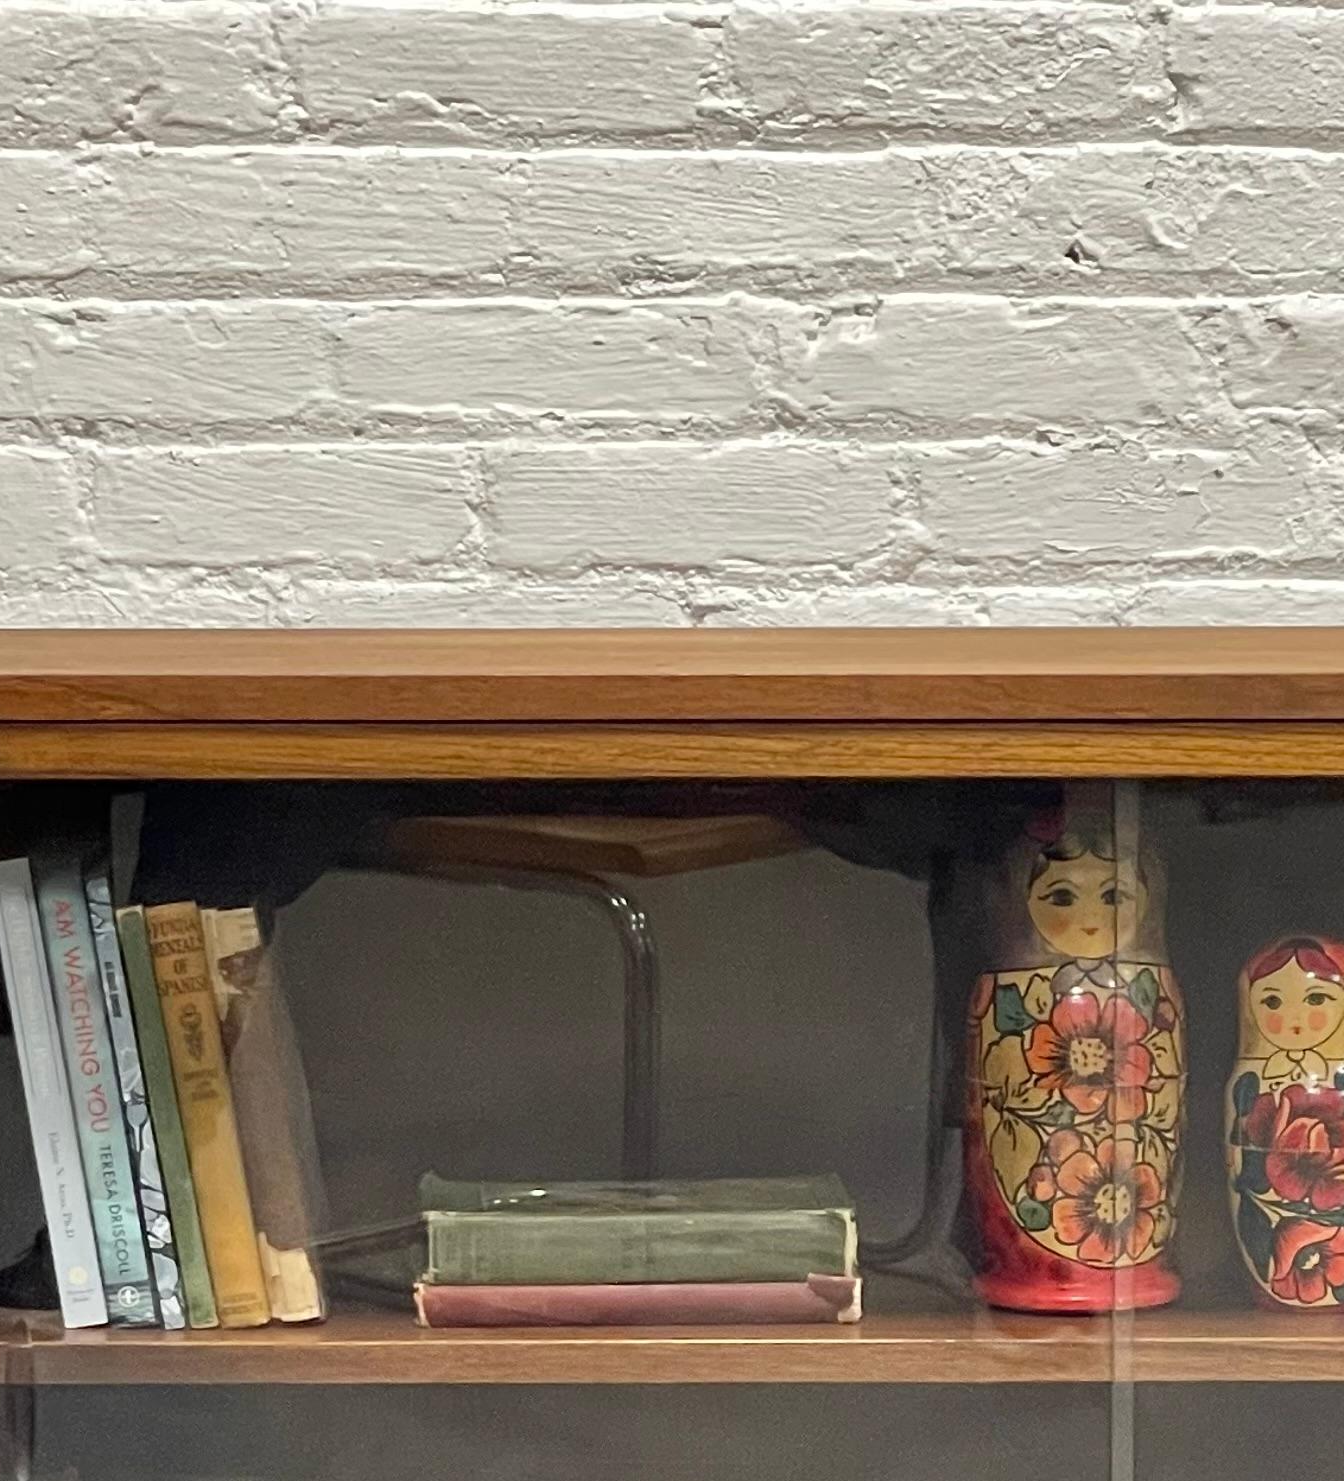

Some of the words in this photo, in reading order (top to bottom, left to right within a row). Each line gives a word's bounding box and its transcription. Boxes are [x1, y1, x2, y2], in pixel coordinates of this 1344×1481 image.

[53, 899, 74, 939] AM
[64, 945, 101, 1077] WATCHING
[87, 1083, 110, 1133] YOU
[98, 1144, 119, 1200] TERESA
[108, 1204, 133, 1276] DRISCOLL
